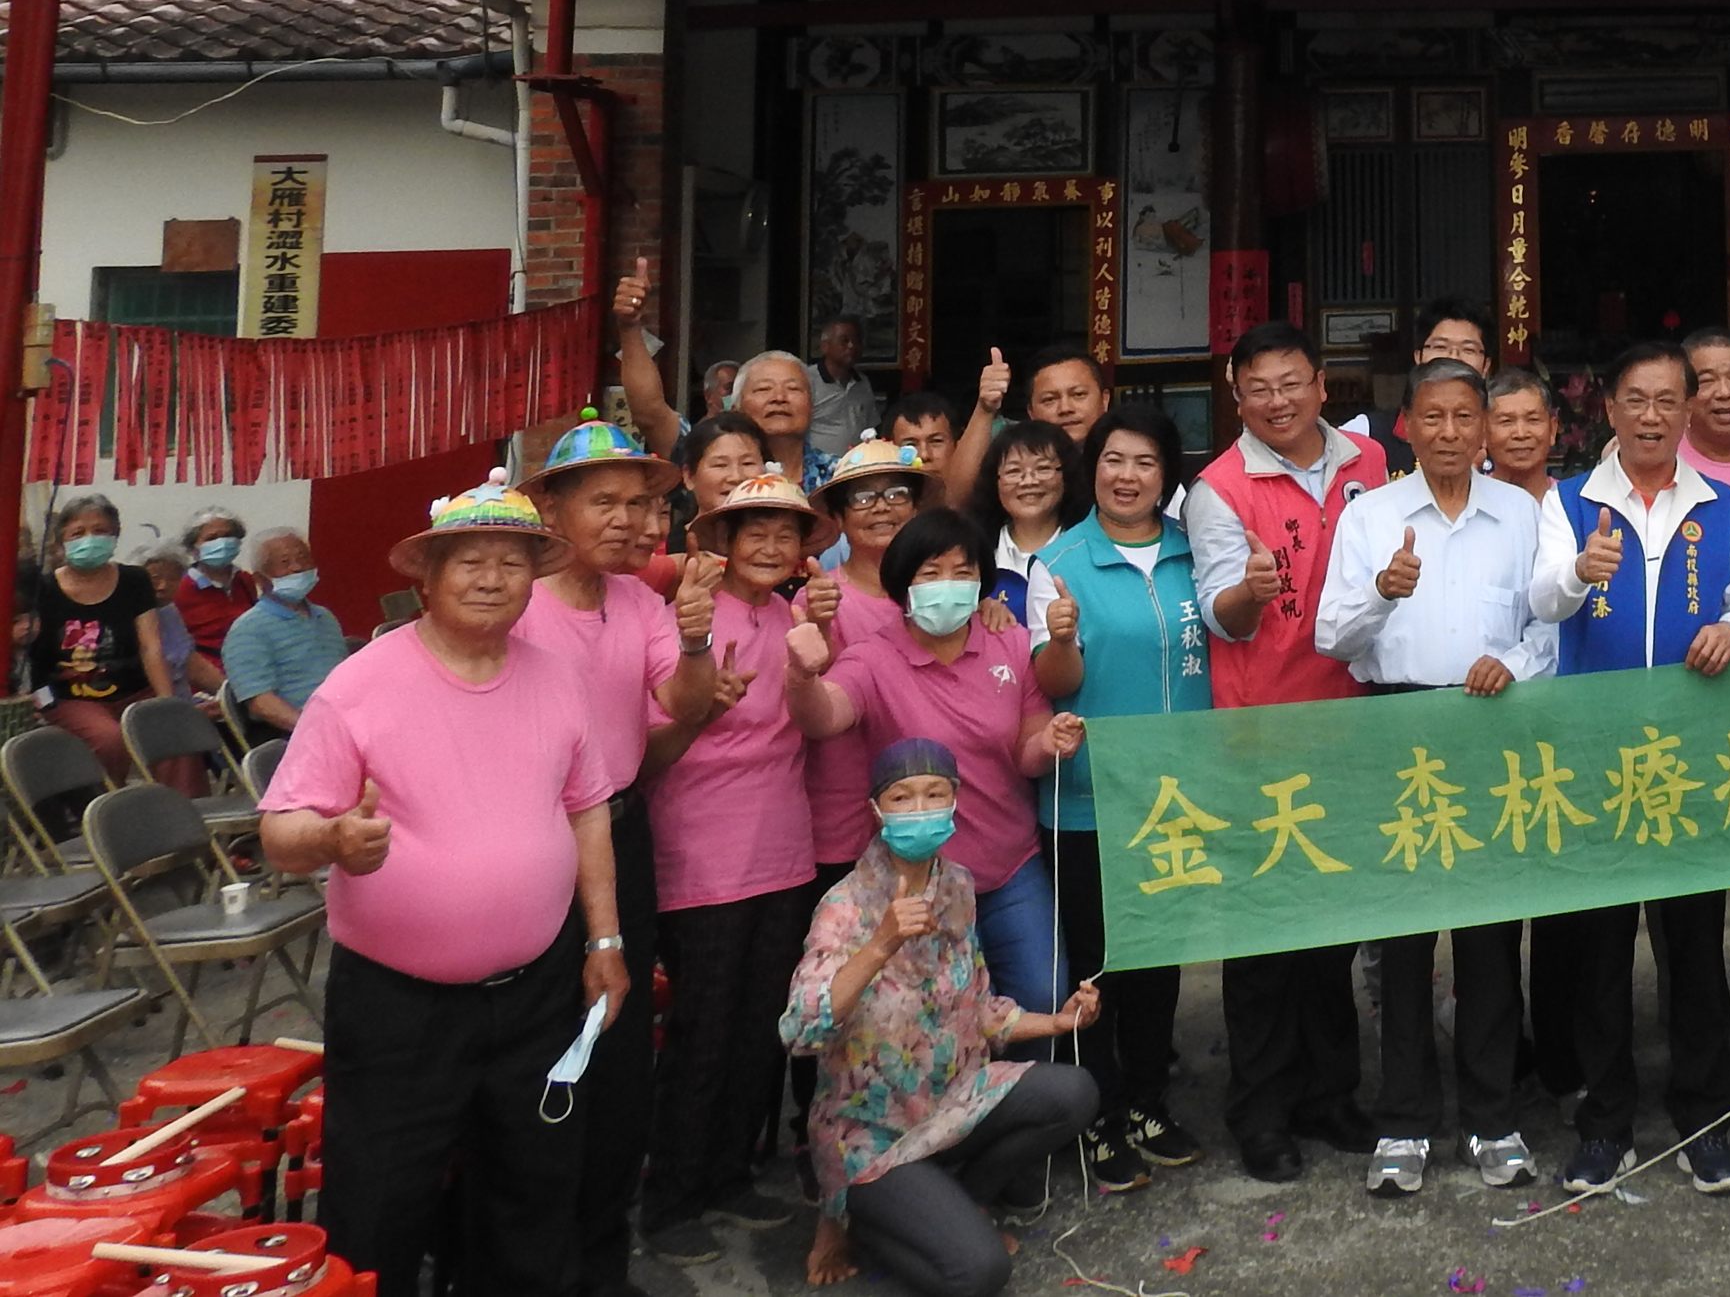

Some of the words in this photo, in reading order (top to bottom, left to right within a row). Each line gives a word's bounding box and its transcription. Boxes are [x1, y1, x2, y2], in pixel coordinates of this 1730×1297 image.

[1554, 118, 1709, 145] 明德存馨香
[261, 166, 308, 336] 大雁村澀水重建委
[1180, 600, 1204, 677] 王秋淑
